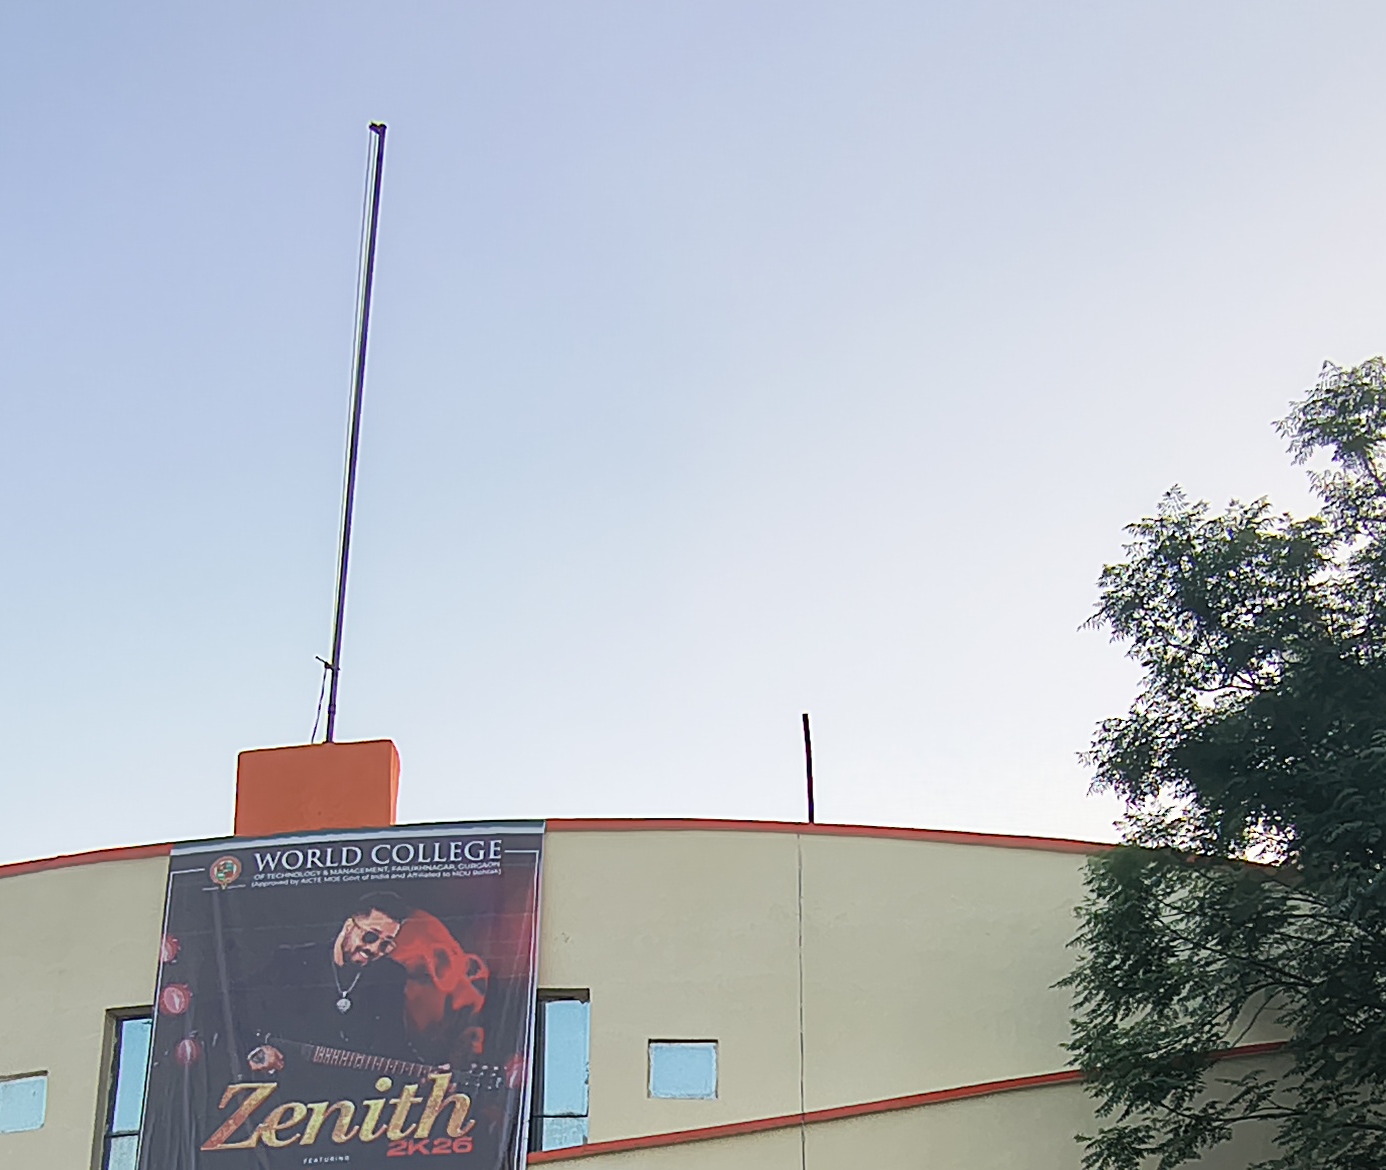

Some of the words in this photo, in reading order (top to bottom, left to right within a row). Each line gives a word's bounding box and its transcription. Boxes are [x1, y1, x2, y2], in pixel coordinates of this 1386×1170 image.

[254, 846, 363, 872] WORLD
[371, 839, 502, 865] COLLEGE
[254, 873, 265, 881] OF
[267, 870, 321, 880] TECHNOLOGY
[290, 878, 300, 888] by
[362, 873, 370, 881] of
[390, 871, 406, 880] and
[442, 870, 451, 878] to
[200, 1072, 475, 1151] Zenith
[386, 1136, 474, 1157] 2K26
[302, 1155, 350, 1165] FEATURING
